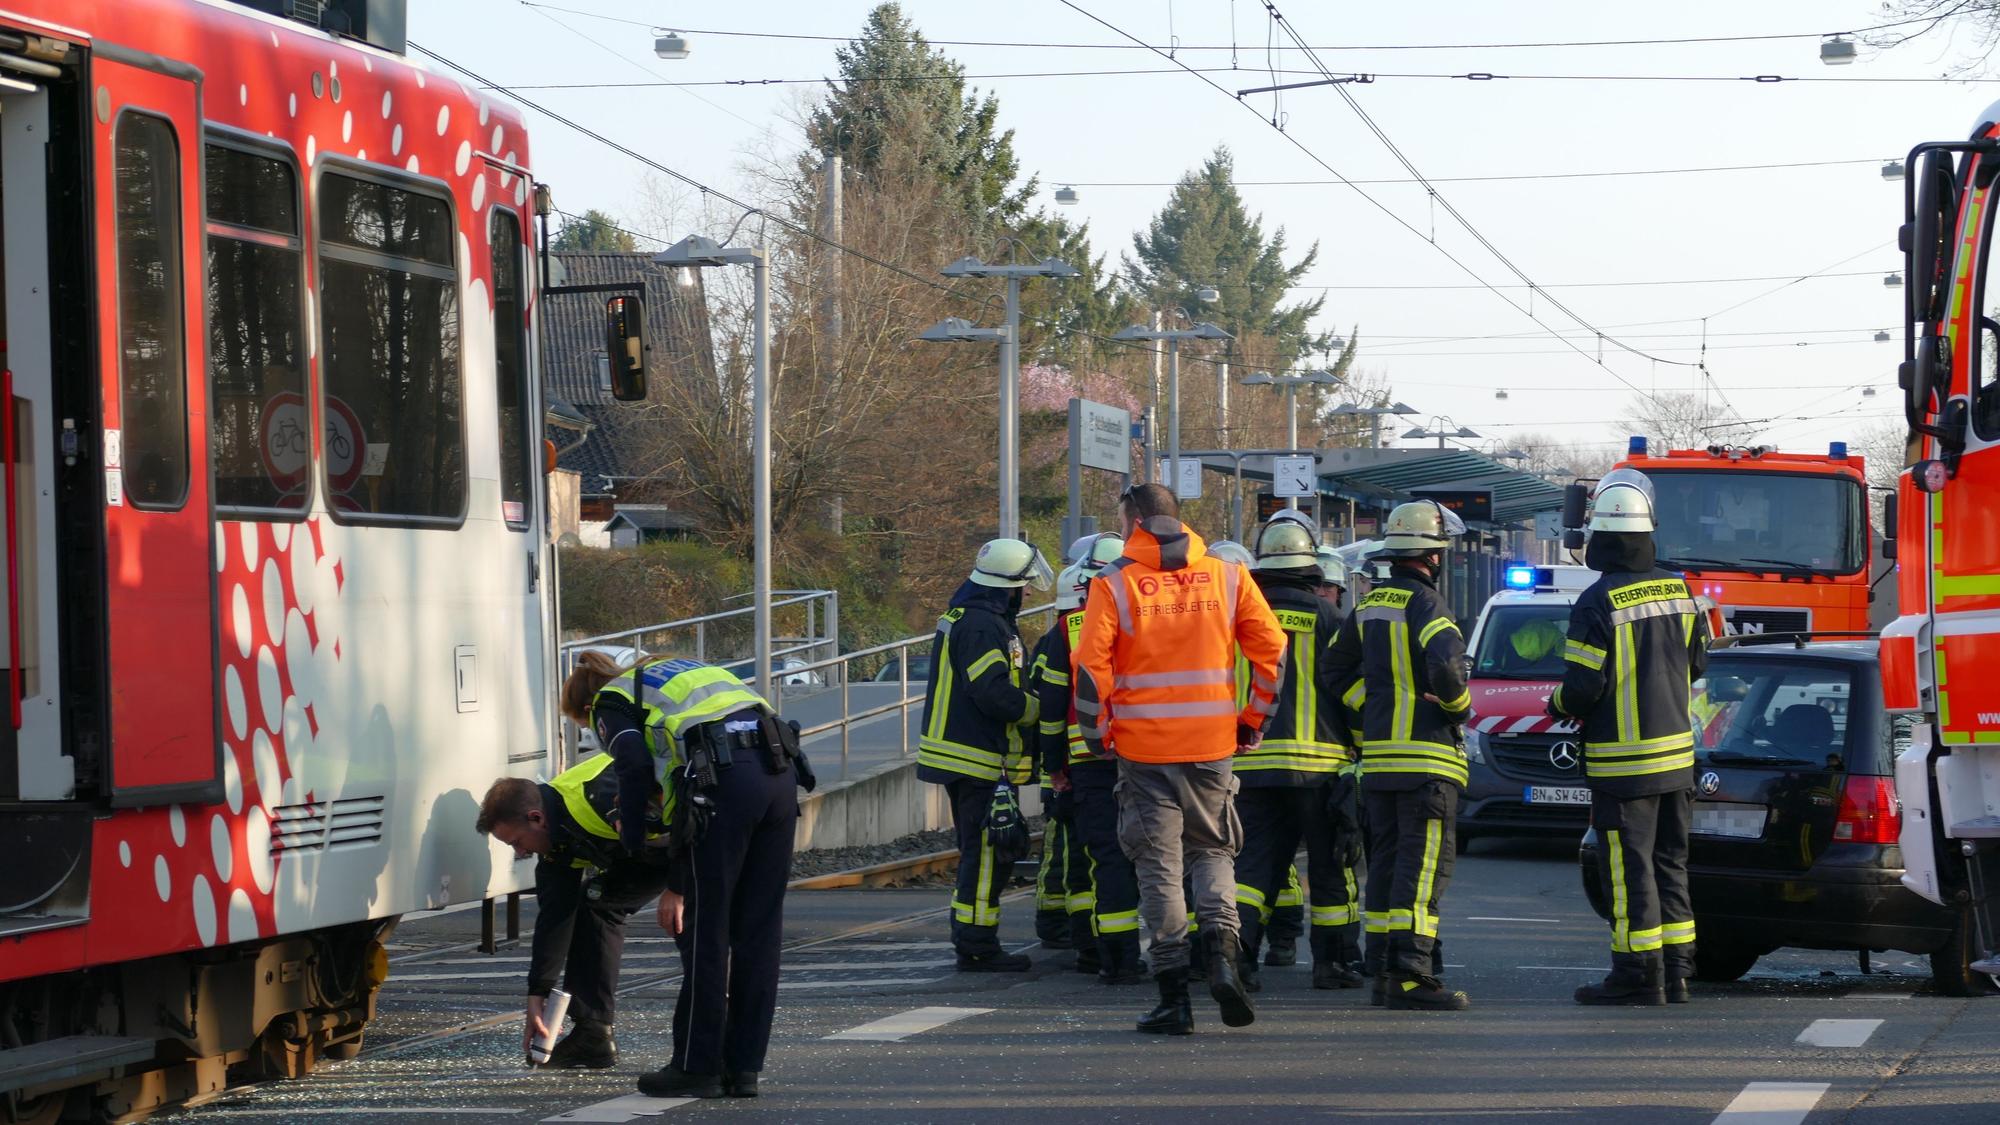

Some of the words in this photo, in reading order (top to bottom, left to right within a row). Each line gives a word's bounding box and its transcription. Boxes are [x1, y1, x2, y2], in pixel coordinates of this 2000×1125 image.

[1615, 503, 1621, 511] 2
[1162, 572, 1211, 586] SWB
[1386, 592, 1409, 605] BONN
[1613, 585, 1661, 605] FEUERWEHR
[1664, 582, 1685, 596] BONN
[1135, 600, 1220, 617] BETRIEBSLEITER
[1286, 615, 1315, 629] BONN
[1532, 788, 1546, 801] BN
